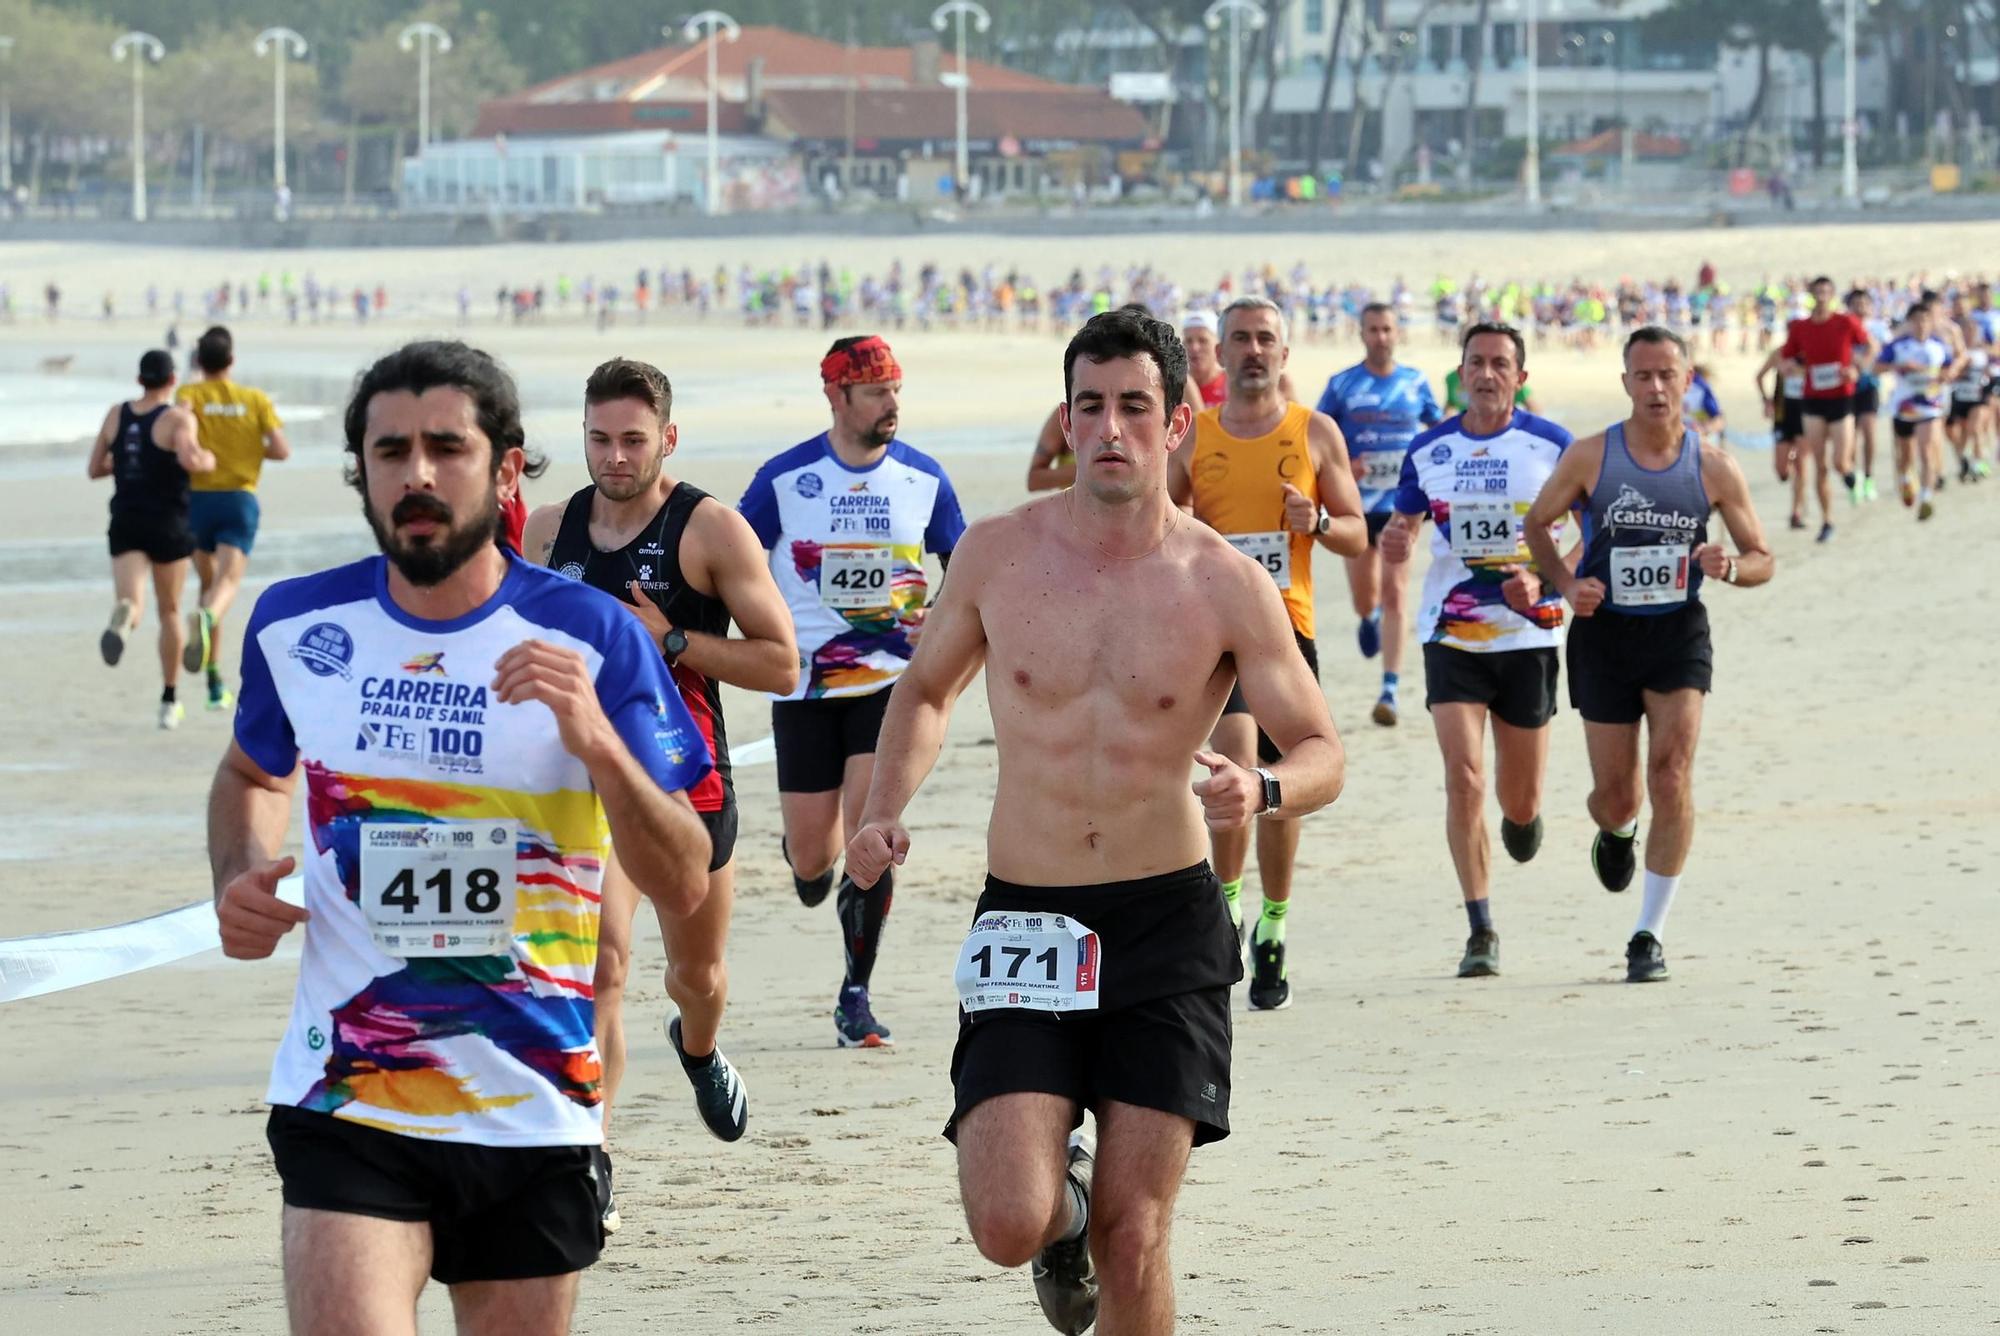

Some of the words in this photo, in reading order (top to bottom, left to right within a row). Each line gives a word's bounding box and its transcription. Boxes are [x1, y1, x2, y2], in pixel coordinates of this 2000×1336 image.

[1455, 460, 1508, 470] CARREIRA
[1485, 479, 1507, 489] 100
[830, 495, 890, 507] CARREIRA
[864, 517, 890, 530] 100
[1460, 520, 1510, 540] 134
[831, 568, 885, 590] 420
[1621, 565, 1670, 588] 306
[361, 677, 488, 709] CARREIRA
[360, 701, 411, 719] PRAIA
[415, 706, 435, 721] DE
[438, 708, 485, 725] SAMIL
[428, 727, 483, 757] 100
[453, 831, 473, 842] 100
[381, 867, 501, 914] 418
[1025, 917, 1042, 927] 100
[970, 944, 1058, 981] 171
[1080, 972, 1088, 987] 171
